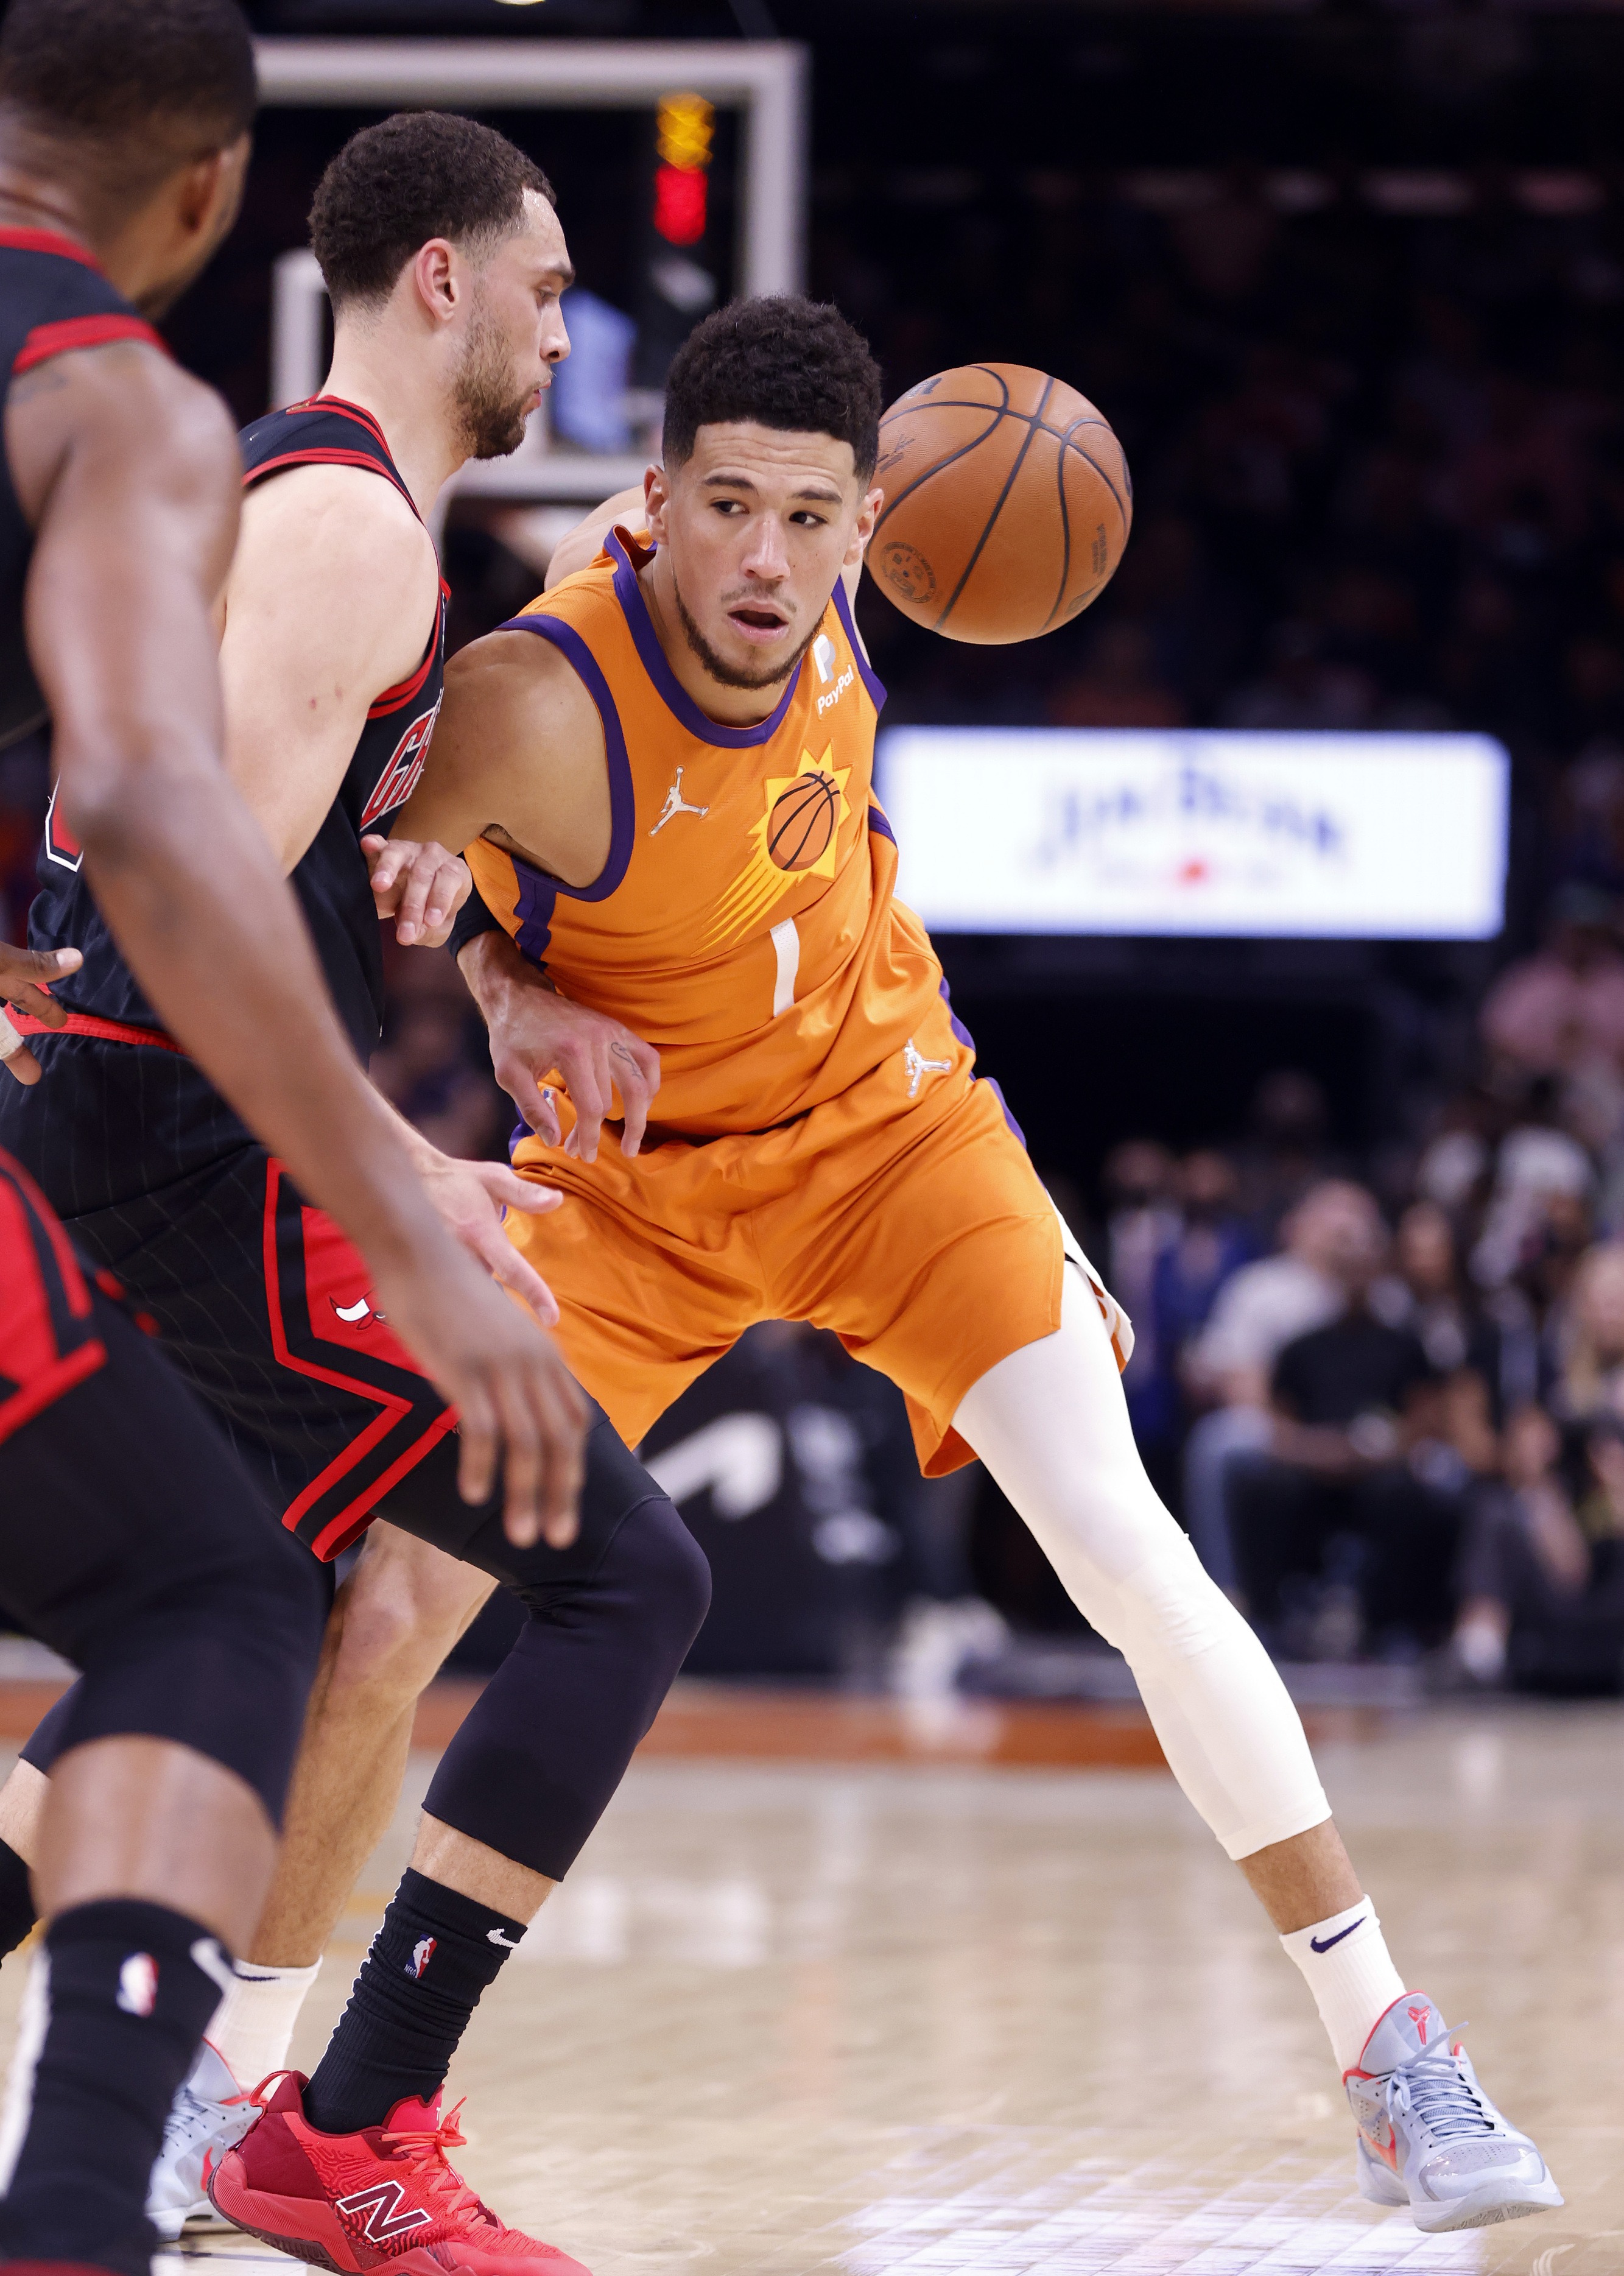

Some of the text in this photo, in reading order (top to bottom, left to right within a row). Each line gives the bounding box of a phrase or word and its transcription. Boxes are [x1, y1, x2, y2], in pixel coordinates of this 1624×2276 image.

[817, 664, 854, 715] PayPal
[769, 917, 800, 1018] 1
[336, 2180, 433, 2243] N
